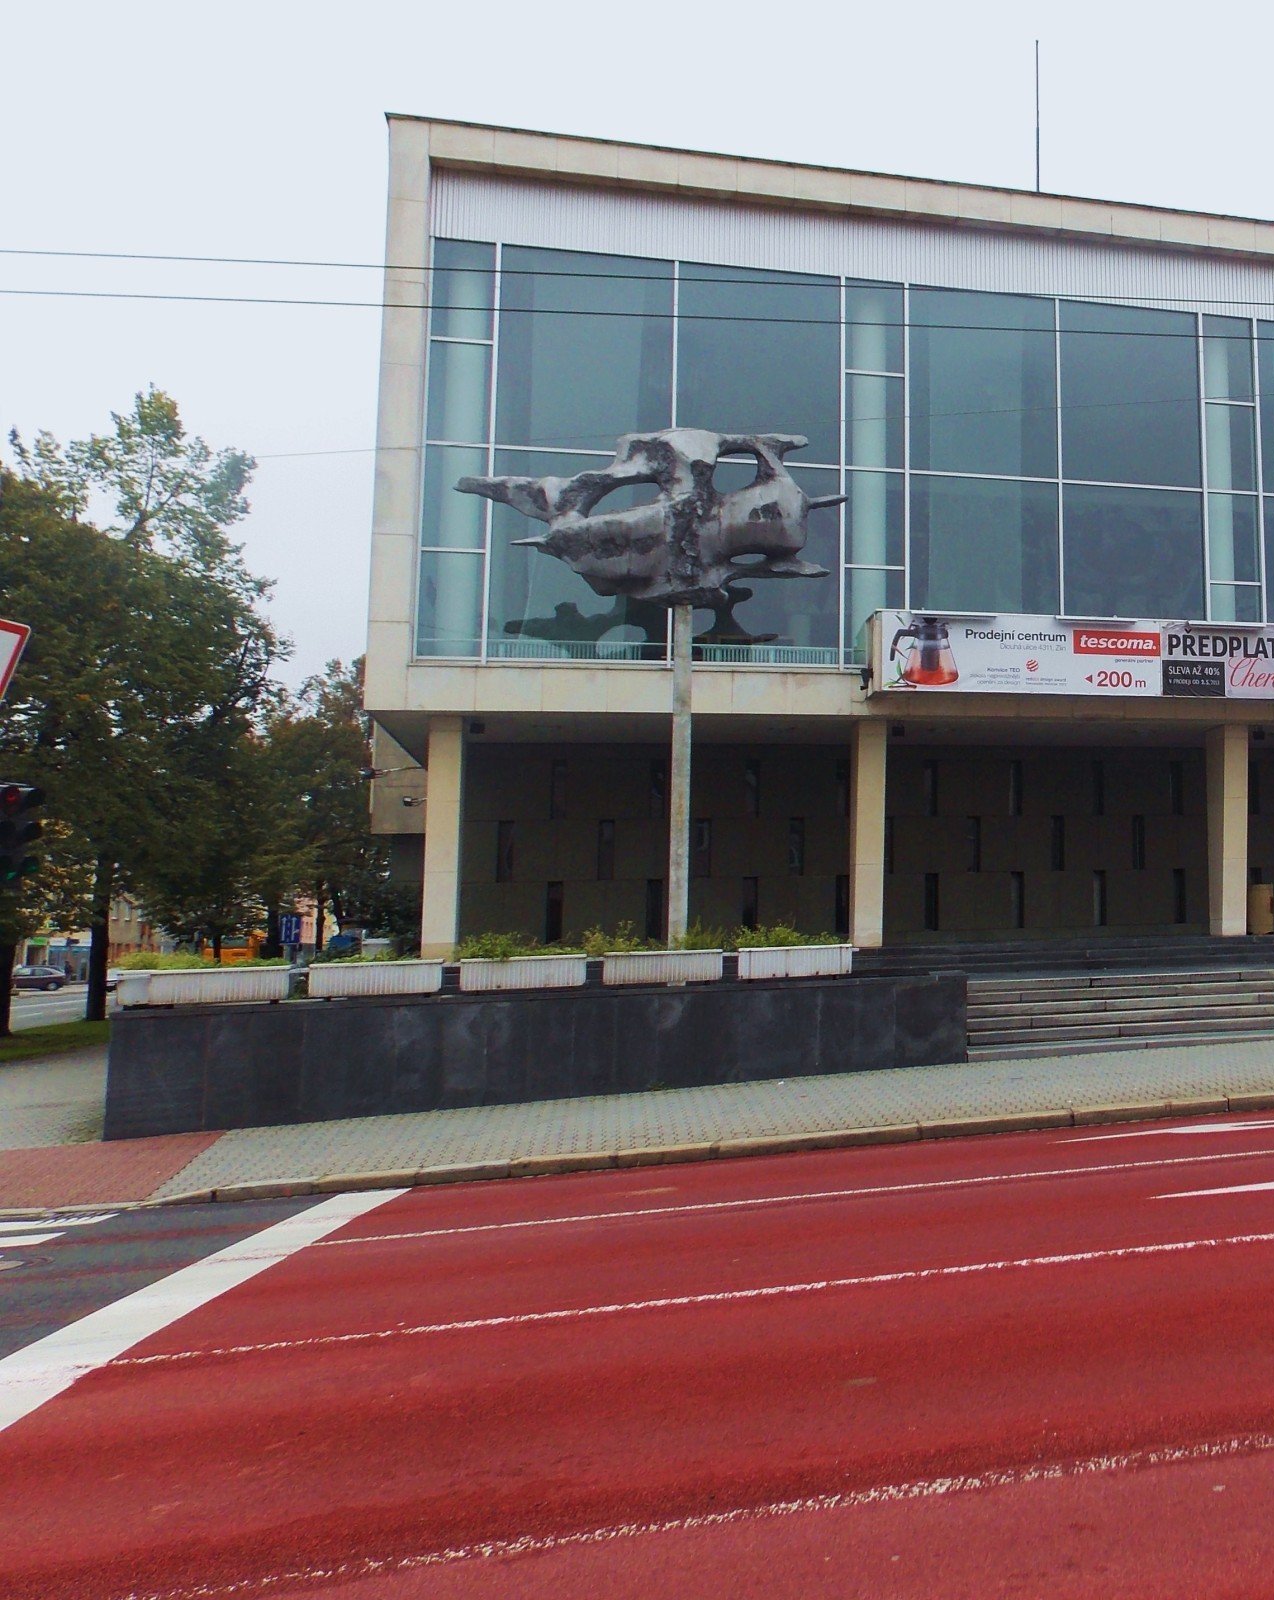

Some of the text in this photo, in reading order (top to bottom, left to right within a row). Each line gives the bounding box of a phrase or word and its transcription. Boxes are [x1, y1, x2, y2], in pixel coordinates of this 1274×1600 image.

[965, 629, 1066, 642] Prodejní centrum
[1168, 665, 1190, 675] SLEVA
[1192, 665, 1202, 676] AŽ
[1097, 670, 1146, 688] 200 m
